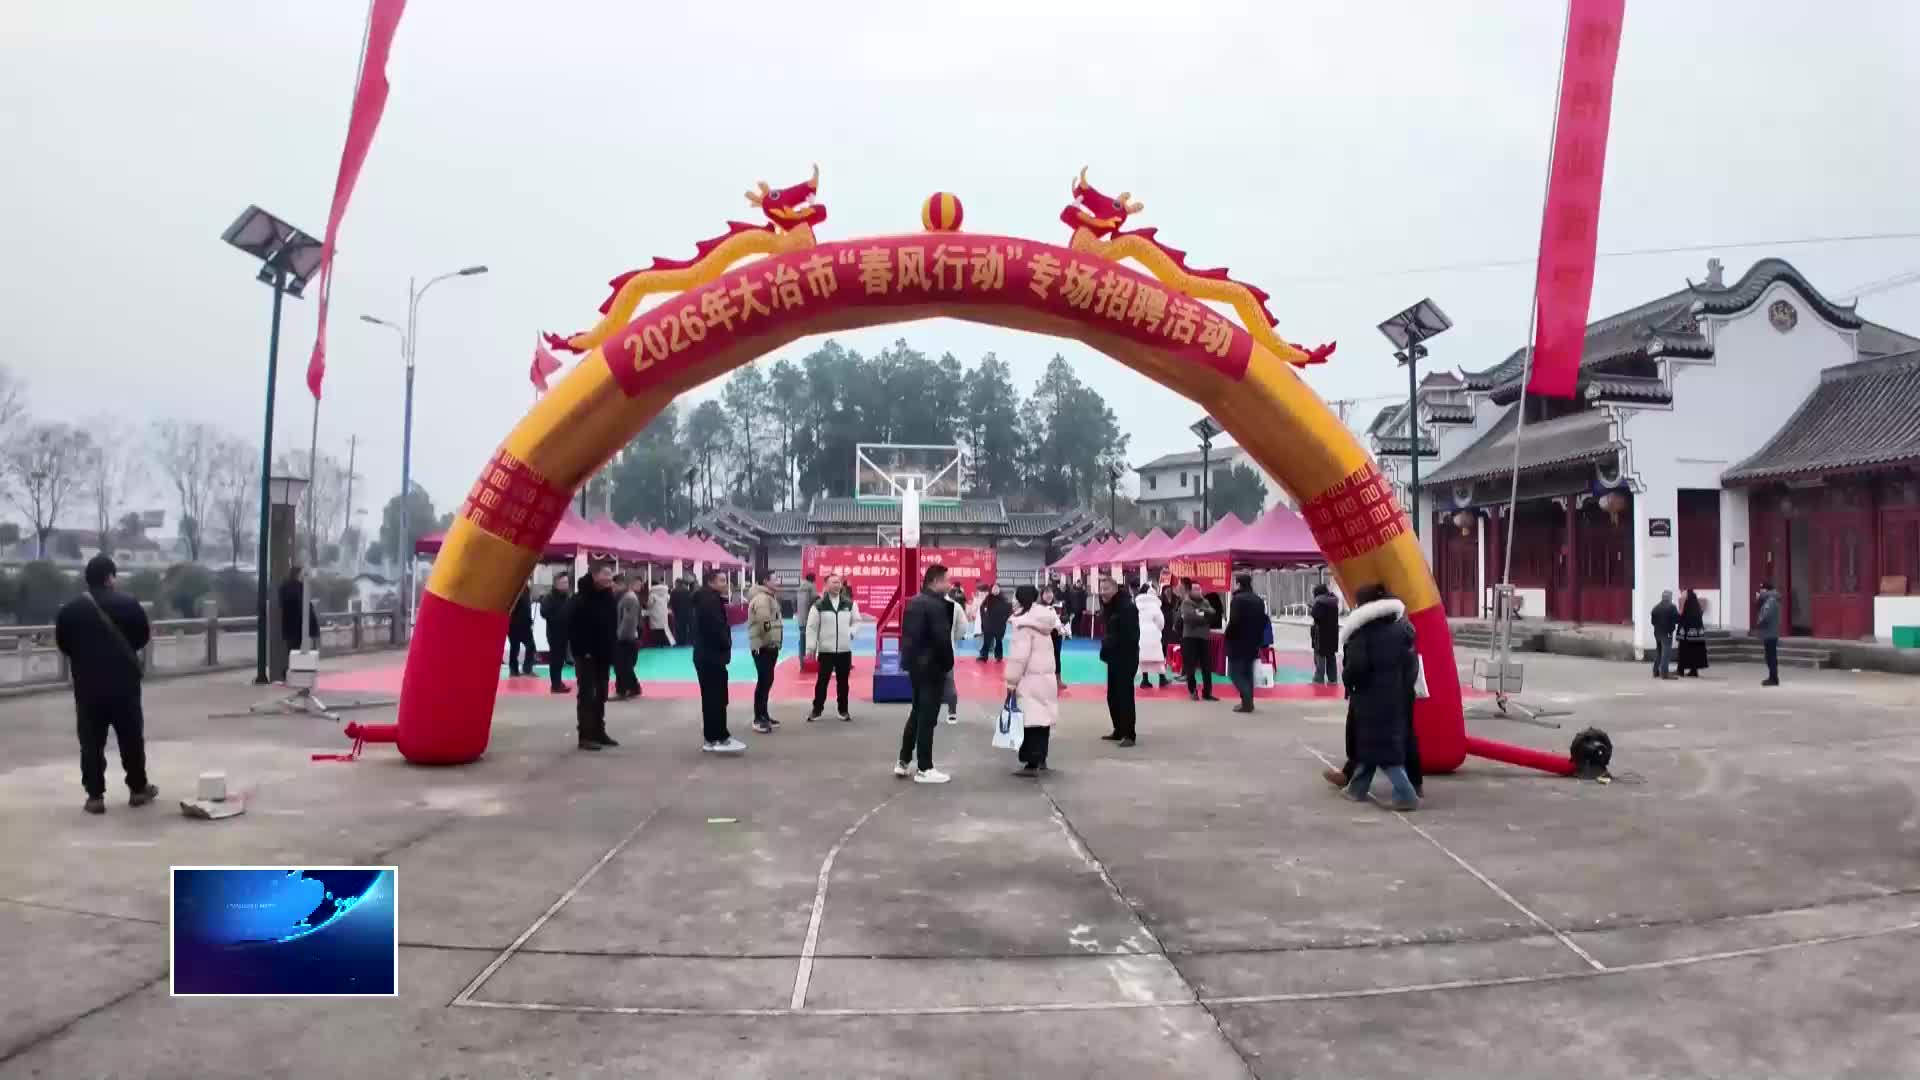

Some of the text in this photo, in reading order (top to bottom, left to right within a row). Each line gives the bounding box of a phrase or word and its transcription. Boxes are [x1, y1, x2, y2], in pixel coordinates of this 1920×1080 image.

[624, 246, 1233, 372] 2026年大冶市“春风行动”专场招聘活动
